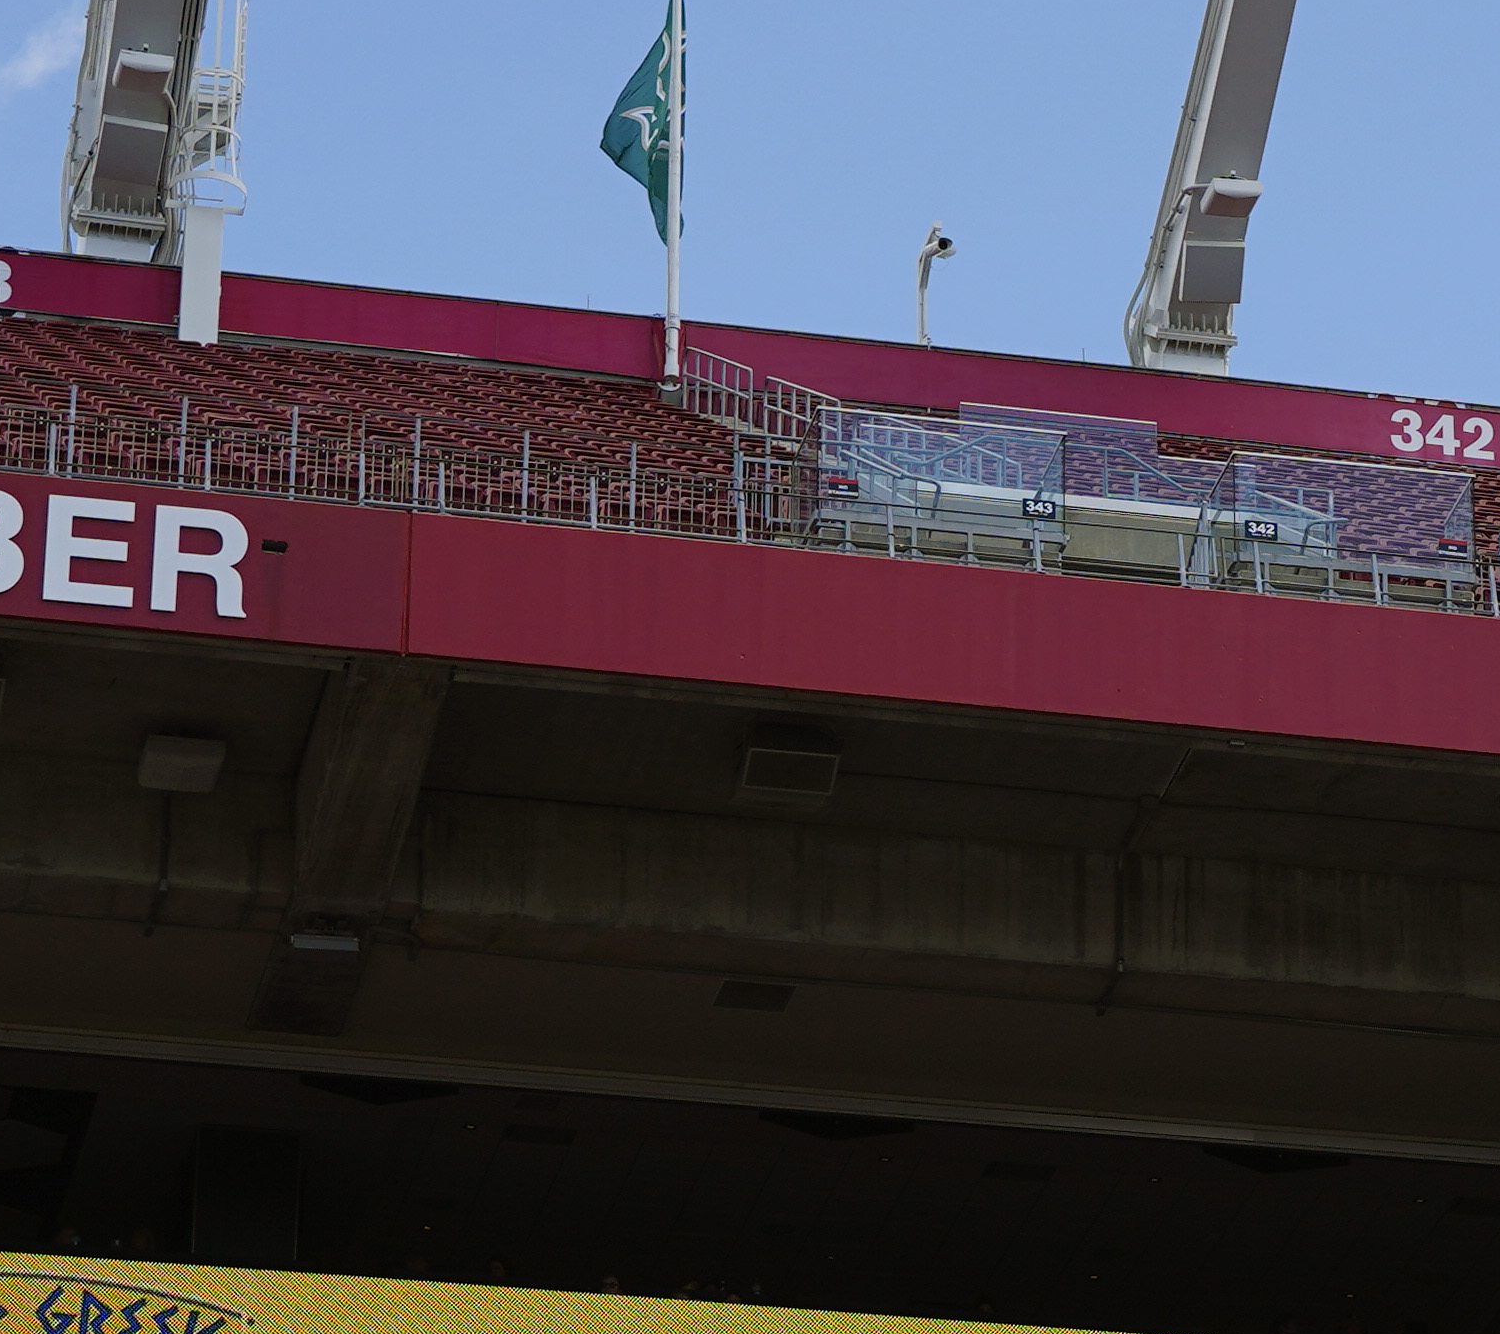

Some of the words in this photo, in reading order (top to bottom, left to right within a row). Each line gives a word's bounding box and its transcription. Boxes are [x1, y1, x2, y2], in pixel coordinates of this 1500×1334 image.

[1390, 408, 1496, 461] 342
[1025, 500, 1053, 514] 343
[1248, 522, 1275, 535] 342
